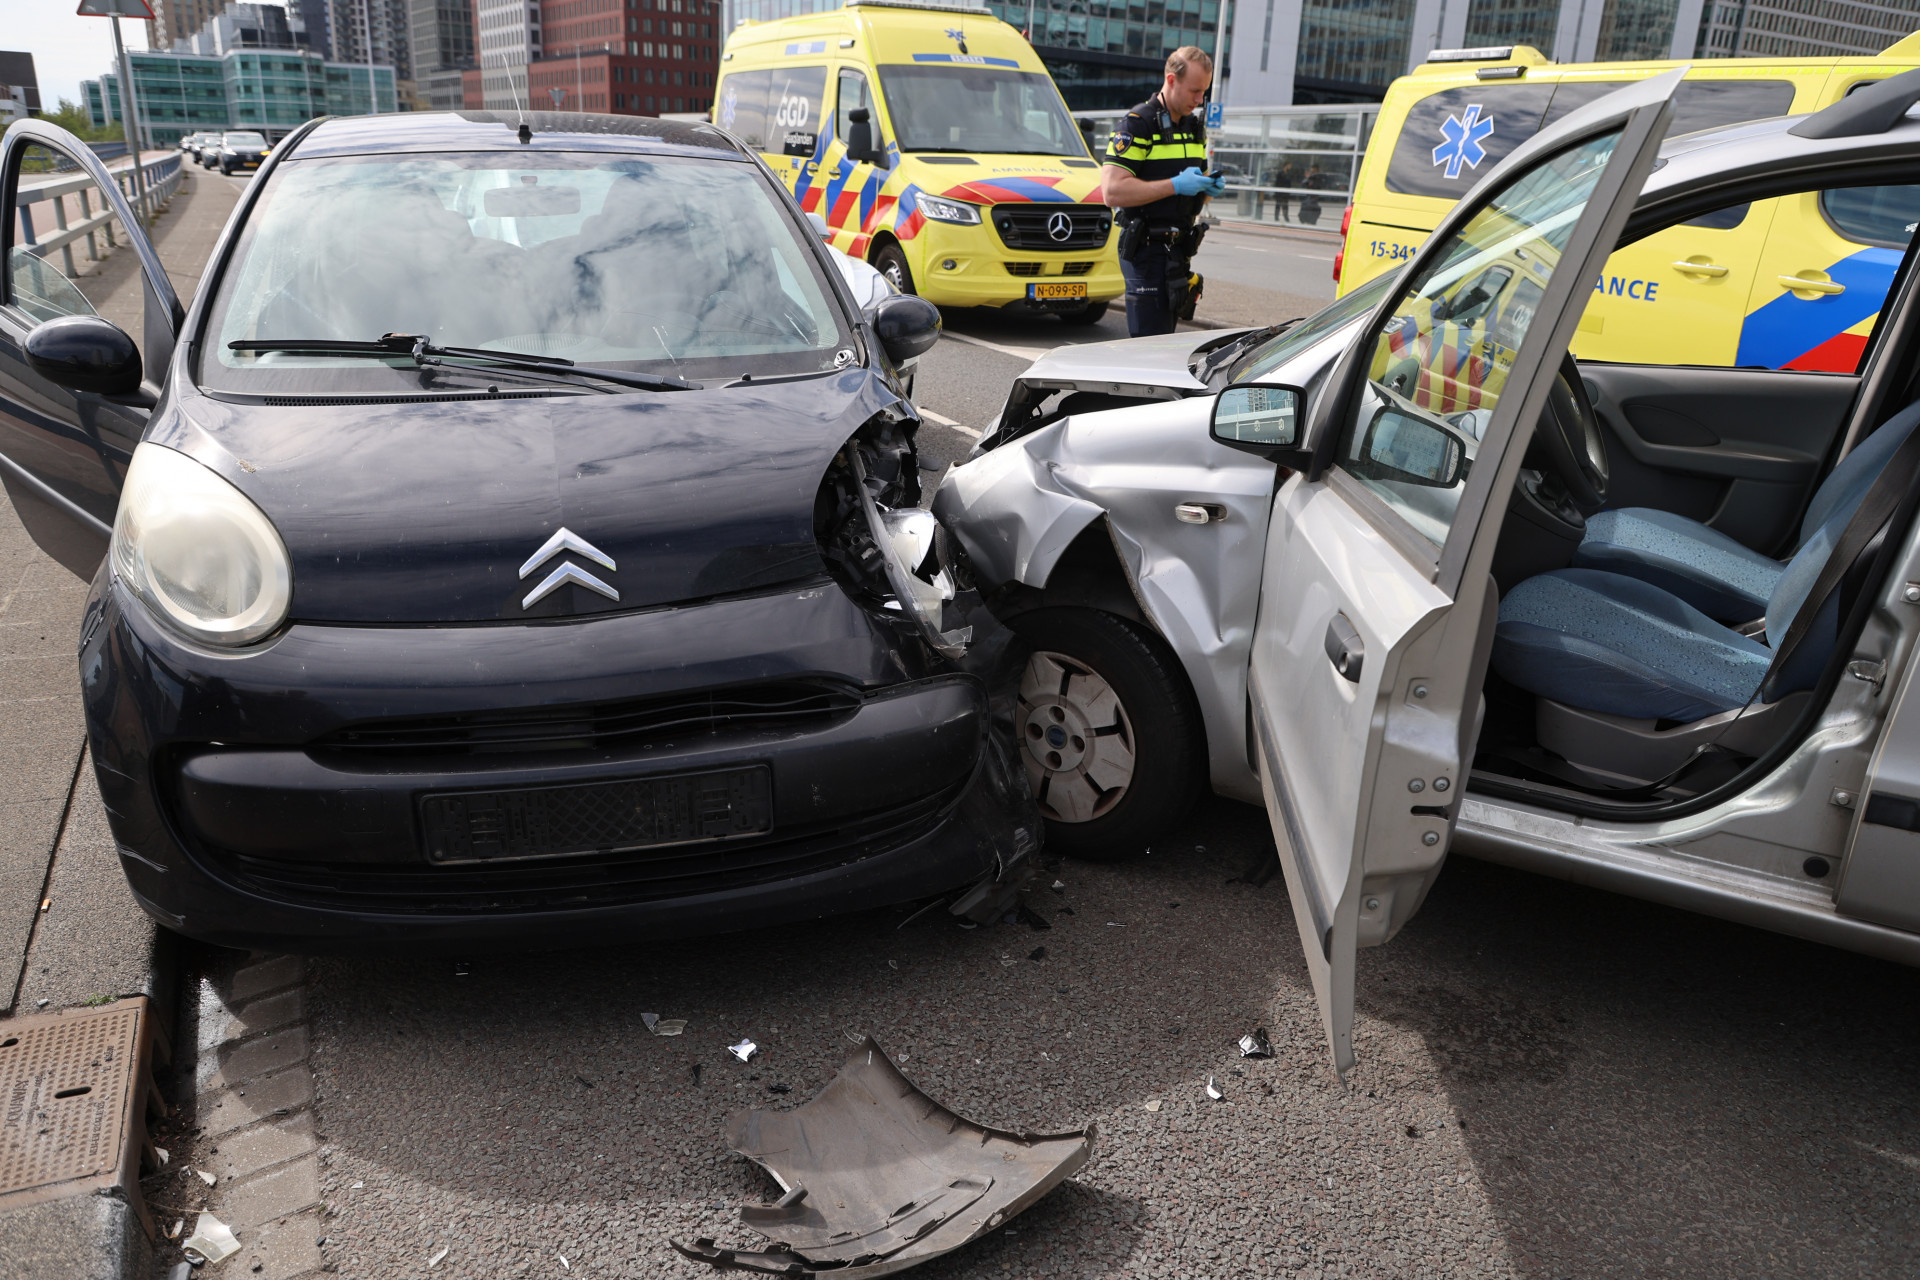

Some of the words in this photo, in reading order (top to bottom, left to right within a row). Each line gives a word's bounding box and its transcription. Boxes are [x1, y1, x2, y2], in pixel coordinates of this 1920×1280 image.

[776, 95, 809, 128] GGD
[1210, 104, 1221, 119] P
[992, 167, 1075, 175] AMBULANCE
[1037, 284, 1085, 297] N-099-SP
